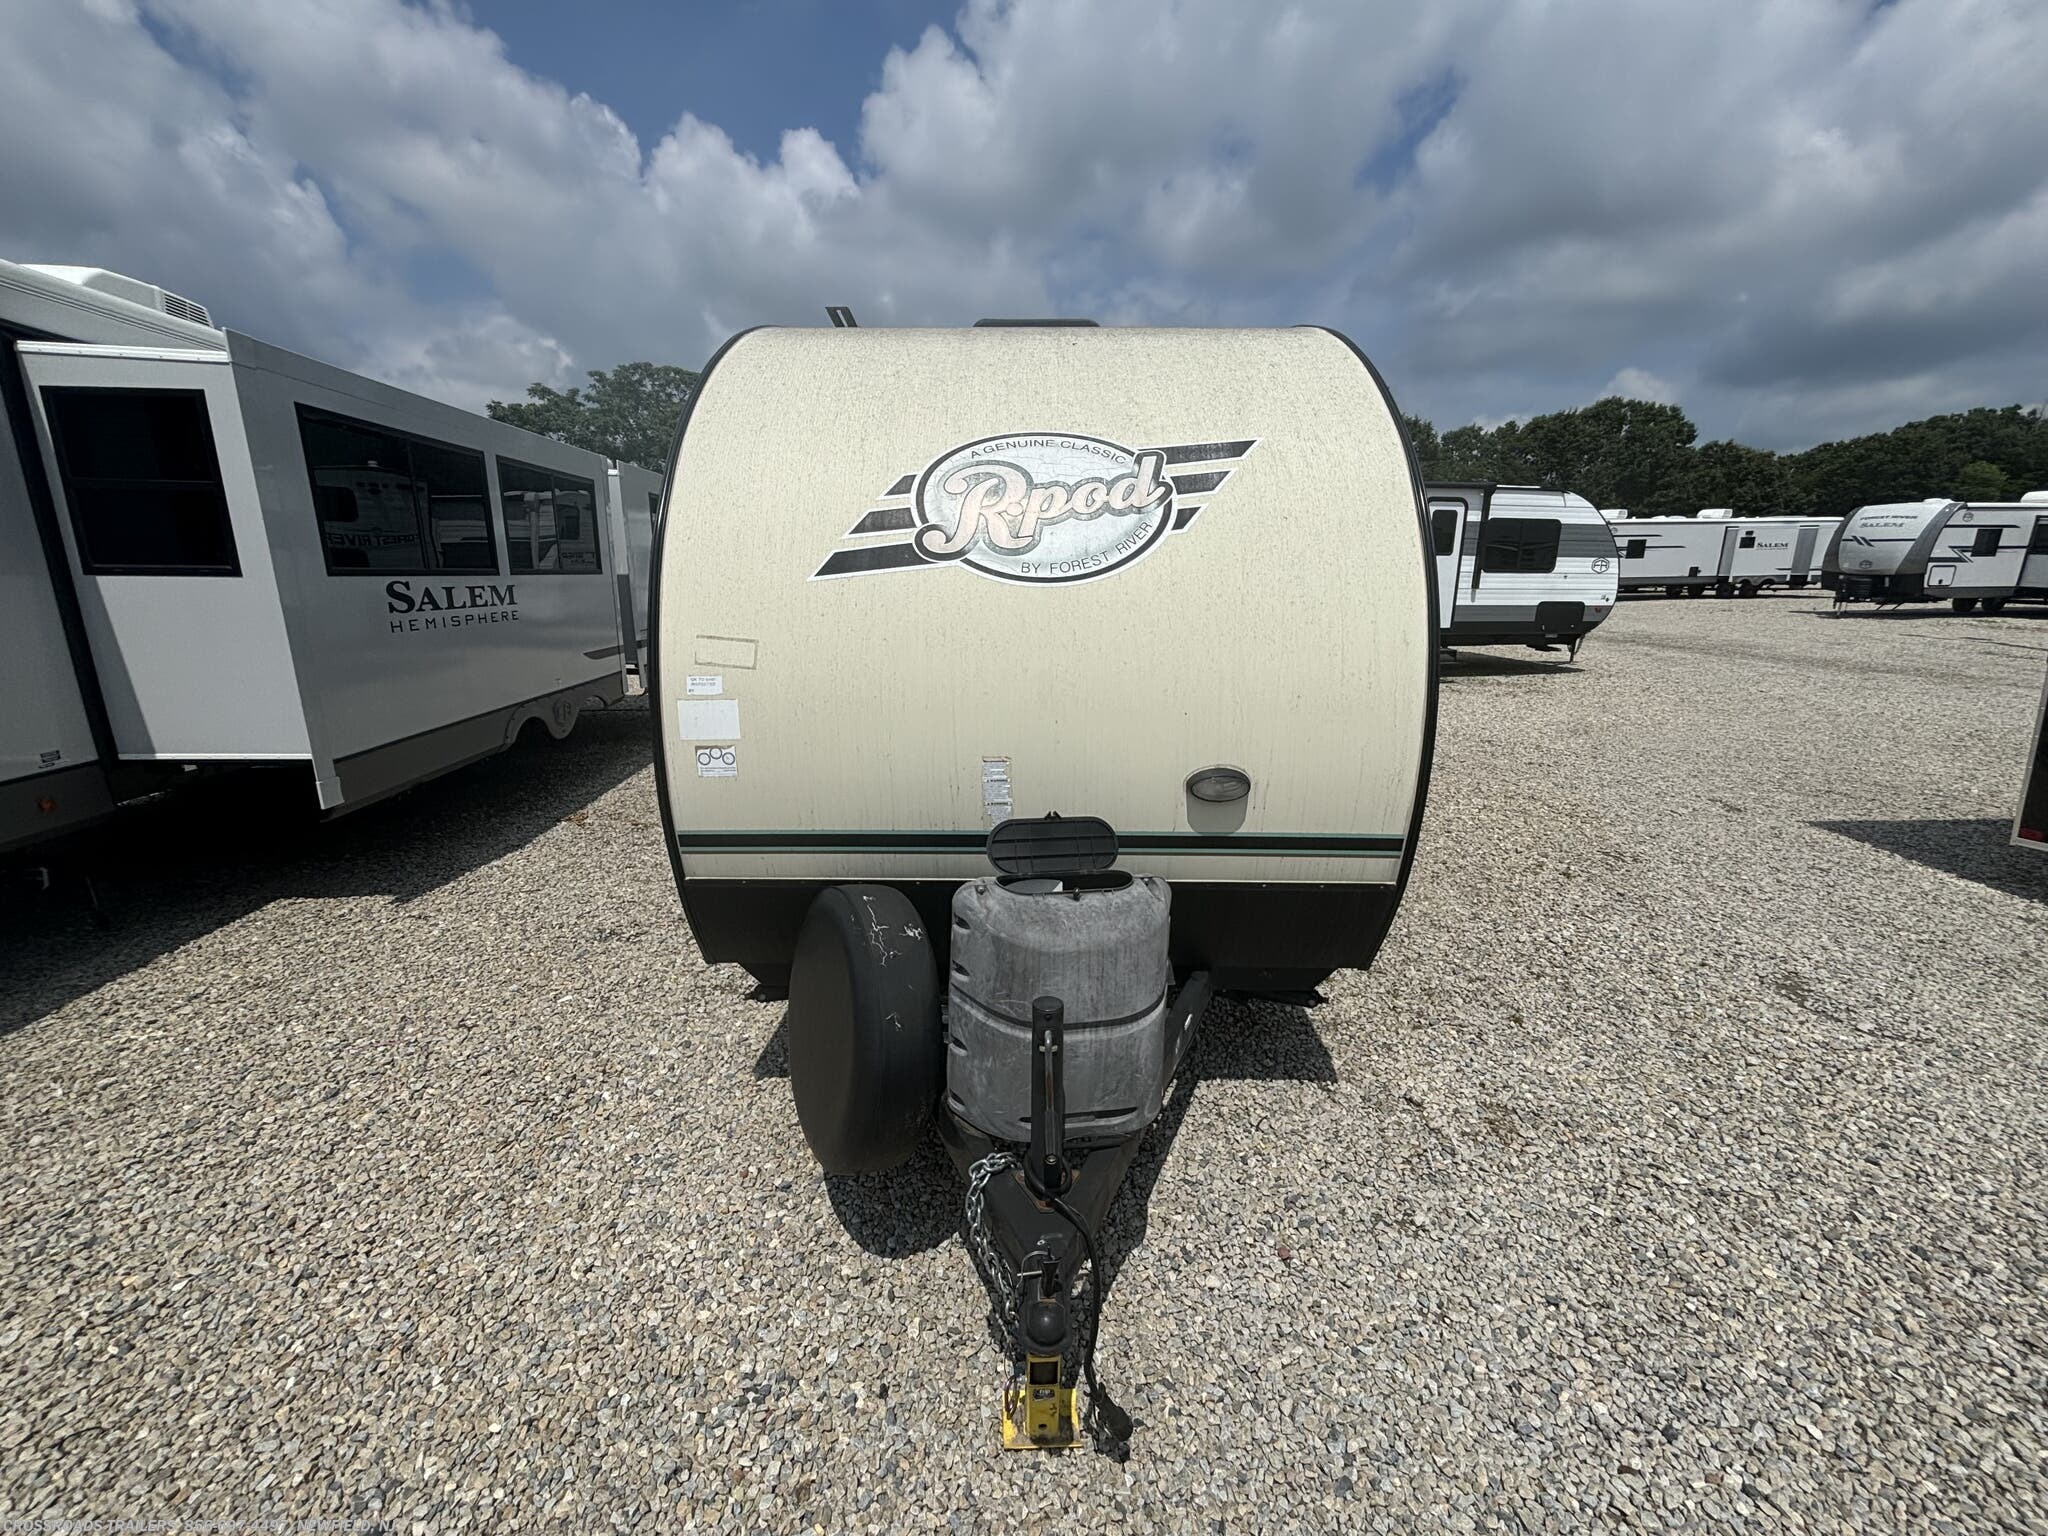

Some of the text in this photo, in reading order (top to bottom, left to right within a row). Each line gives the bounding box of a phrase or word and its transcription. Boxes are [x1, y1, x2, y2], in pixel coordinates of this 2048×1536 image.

[971, 439, 1127, 464] A GENUINE CLASSIC
[1021, 521, 1153, 574] BY FOREST RIVER
[386, 580, 518, 614] SALEM
[390, 610, 519, 633] HEMISPHERE
